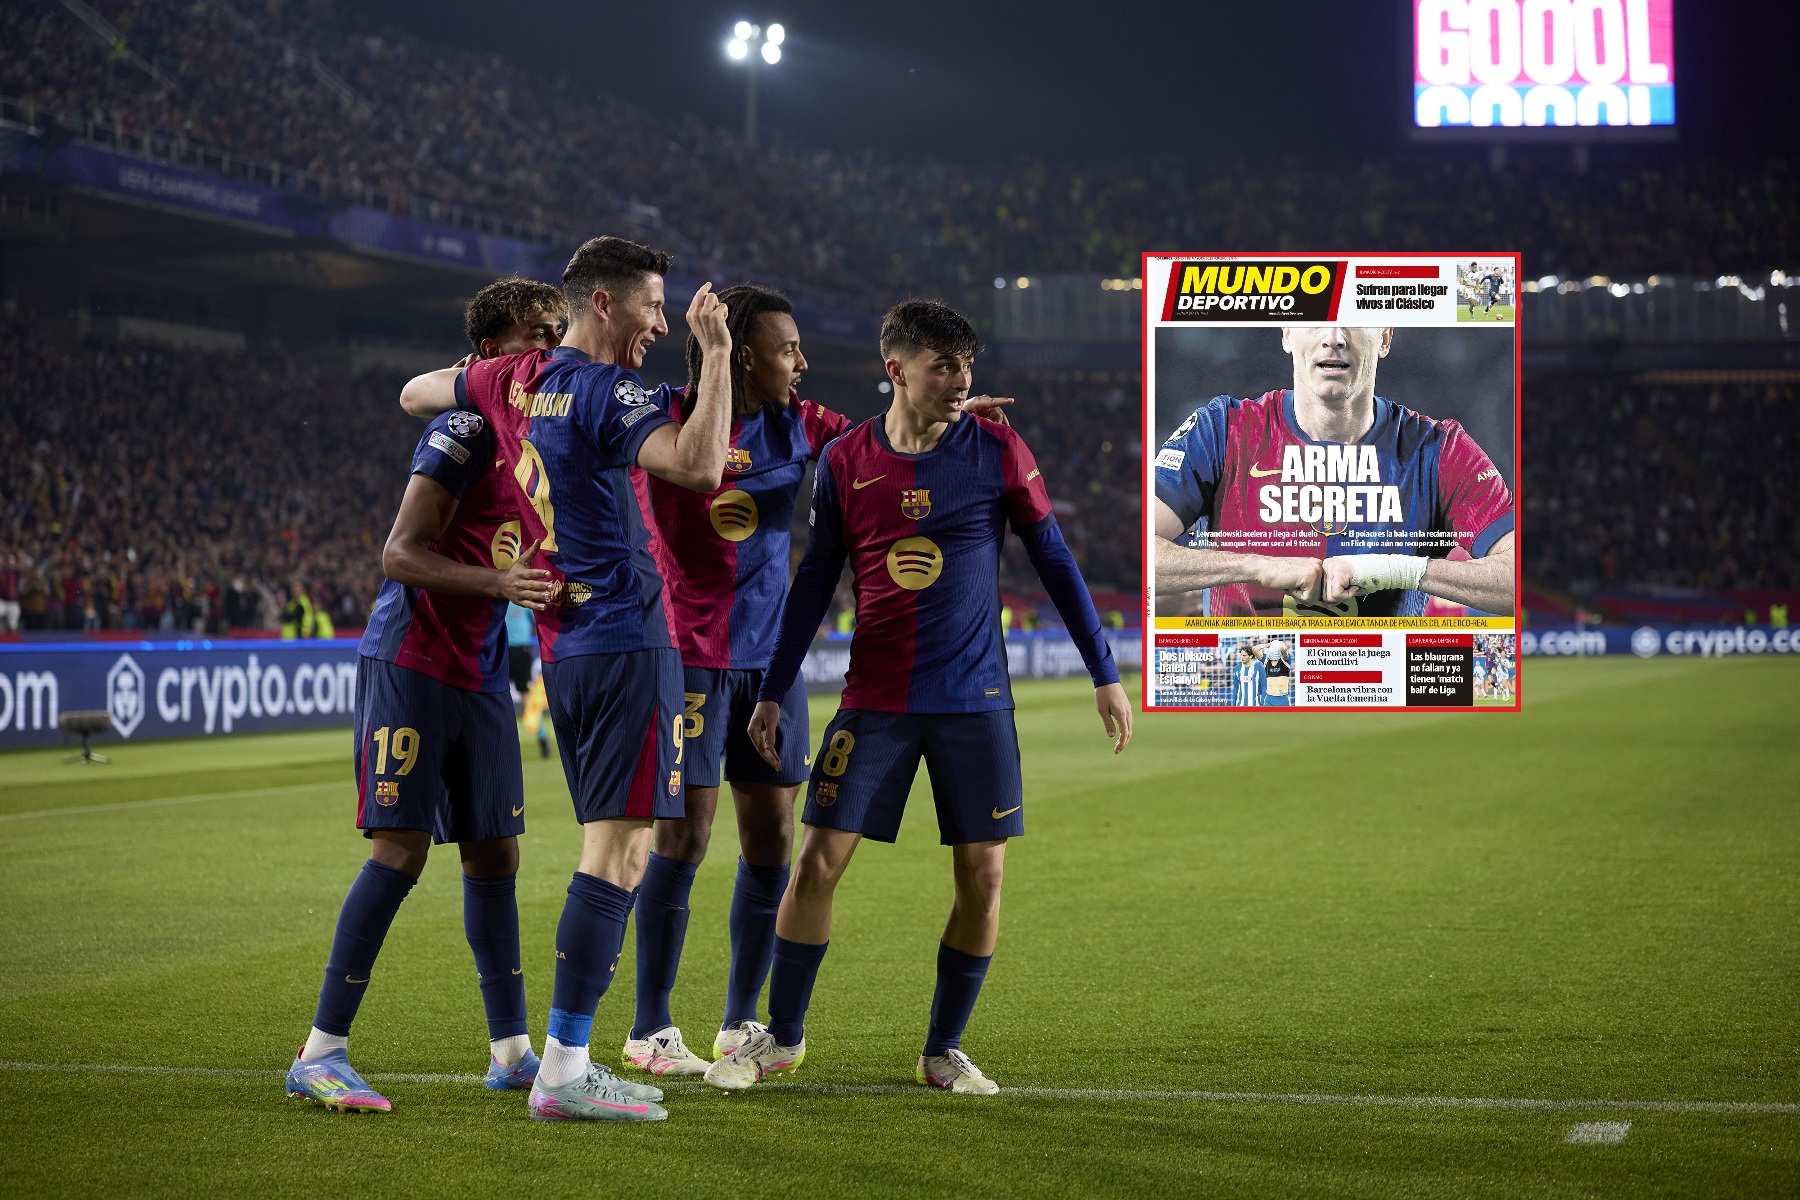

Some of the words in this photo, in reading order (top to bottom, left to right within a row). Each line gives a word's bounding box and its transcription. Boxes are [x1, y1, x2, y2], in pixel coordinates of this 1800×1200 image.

[1418, 0, 1669, 85] GOOOL
[374, 727, 420, 776] 19
[673, 714, 683, 764] 9
[823, 730, 855, 777] 8
